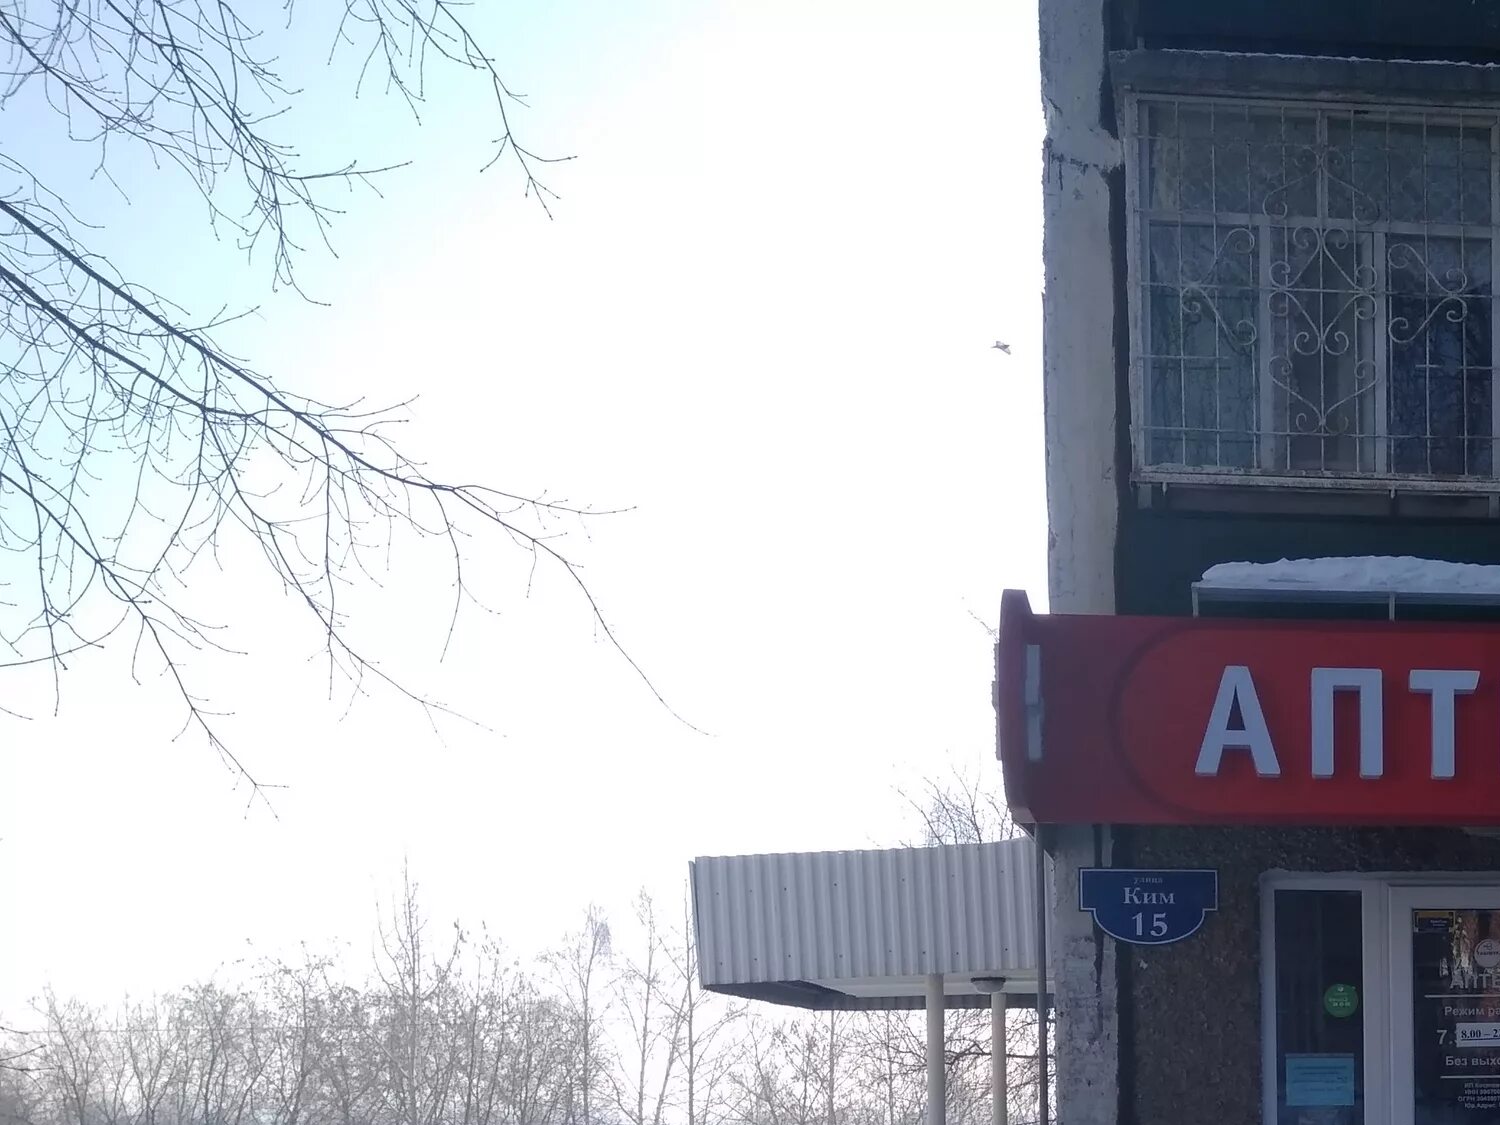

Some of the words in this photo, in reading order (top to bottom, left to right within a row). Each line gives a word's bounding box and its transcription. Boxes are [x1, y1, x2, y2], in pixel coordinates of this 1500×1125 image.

[1123, 887, 1175, 904] Ким
[1132, 912, 1168, 937] 15
[1444, 1006, 1485, 1016] Режим
[1461, 1029, 1481, 1038] 8.00
[1445, 1056, 1468, 1066] Без
